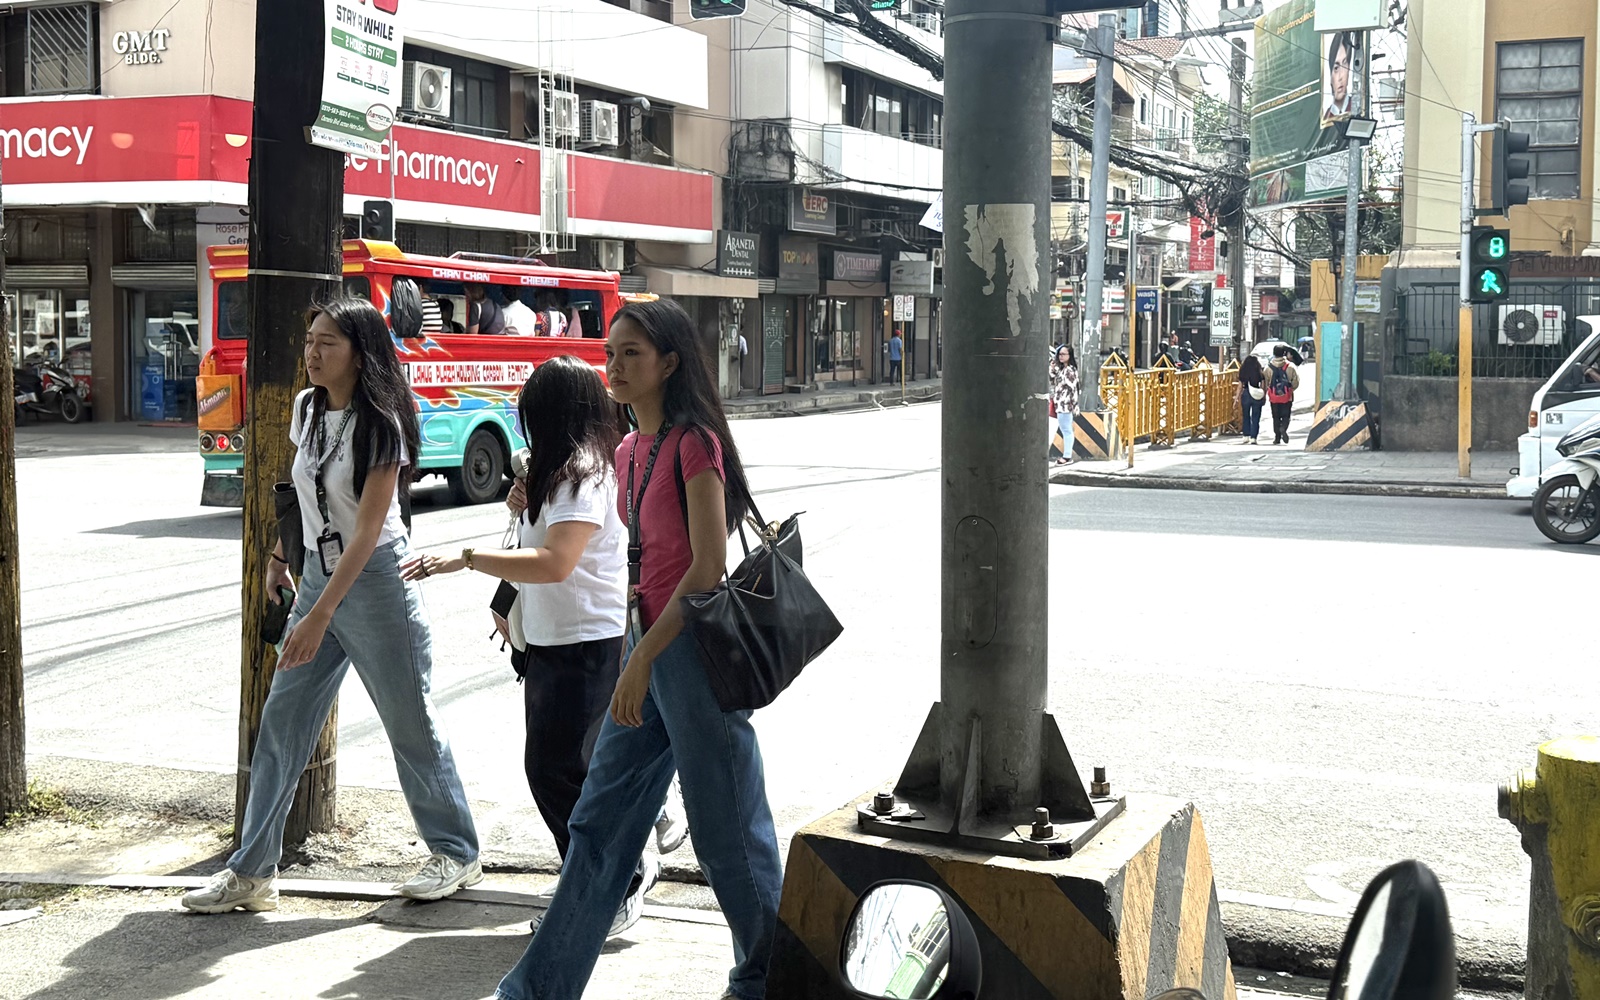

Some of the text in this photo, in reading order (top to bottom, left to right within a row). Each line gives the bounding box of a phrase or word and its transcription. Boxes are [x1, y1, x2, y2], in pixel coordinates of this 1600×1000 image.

[336, 4, 394, 41] STAY A WHILE
[112, 29, 170, 54] GMT
[349, 37, 367, 55] HOURS
[367, 45, 384, 60] STAY
[125, 52, 161, 64] BLDG.
[215, 224, 237, 233] Rose
[1489, 237, 1503, 257] 8
[783, 251, 796, 263] TOP
[846, 256, 880, 271] TIMETABLE
[432, 268, 461, 279] CHAN
[463, 272, 490, 282] CHAN
[1143, 302, 1156, 310] dry
